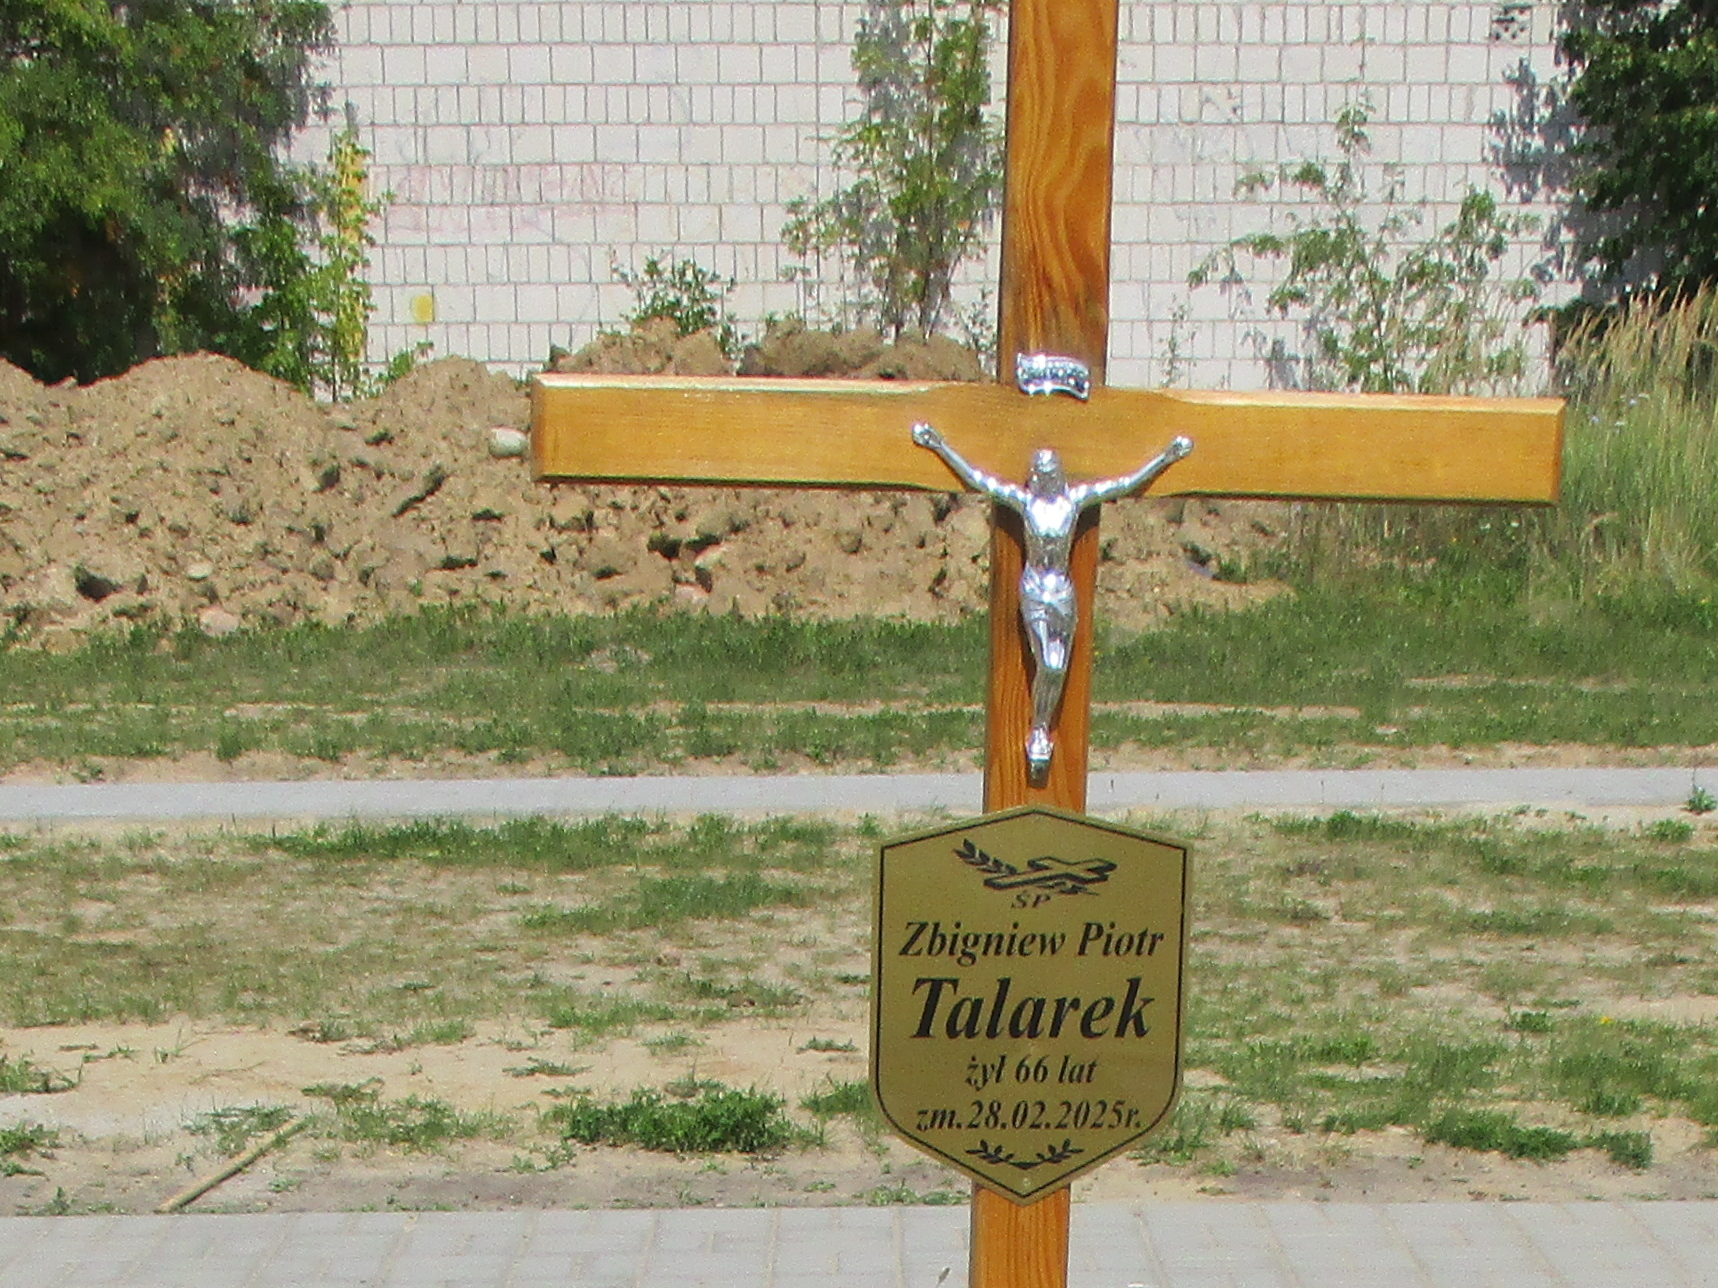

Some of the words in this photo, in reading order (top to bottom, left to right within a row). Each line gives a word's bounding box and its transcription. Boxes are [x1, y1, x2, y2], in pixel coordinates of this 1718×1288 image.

[898, 921, 1066, 966] Zbigniew
[1077, 921, 1165, 957] Piotr
[909, 976, 1156, 1039] Talarek
[965, 1054, 1006, 1090] żył
[1015, 1055, 1049, 1083] 66
[1058, 1054, 1098, 1083] lat
